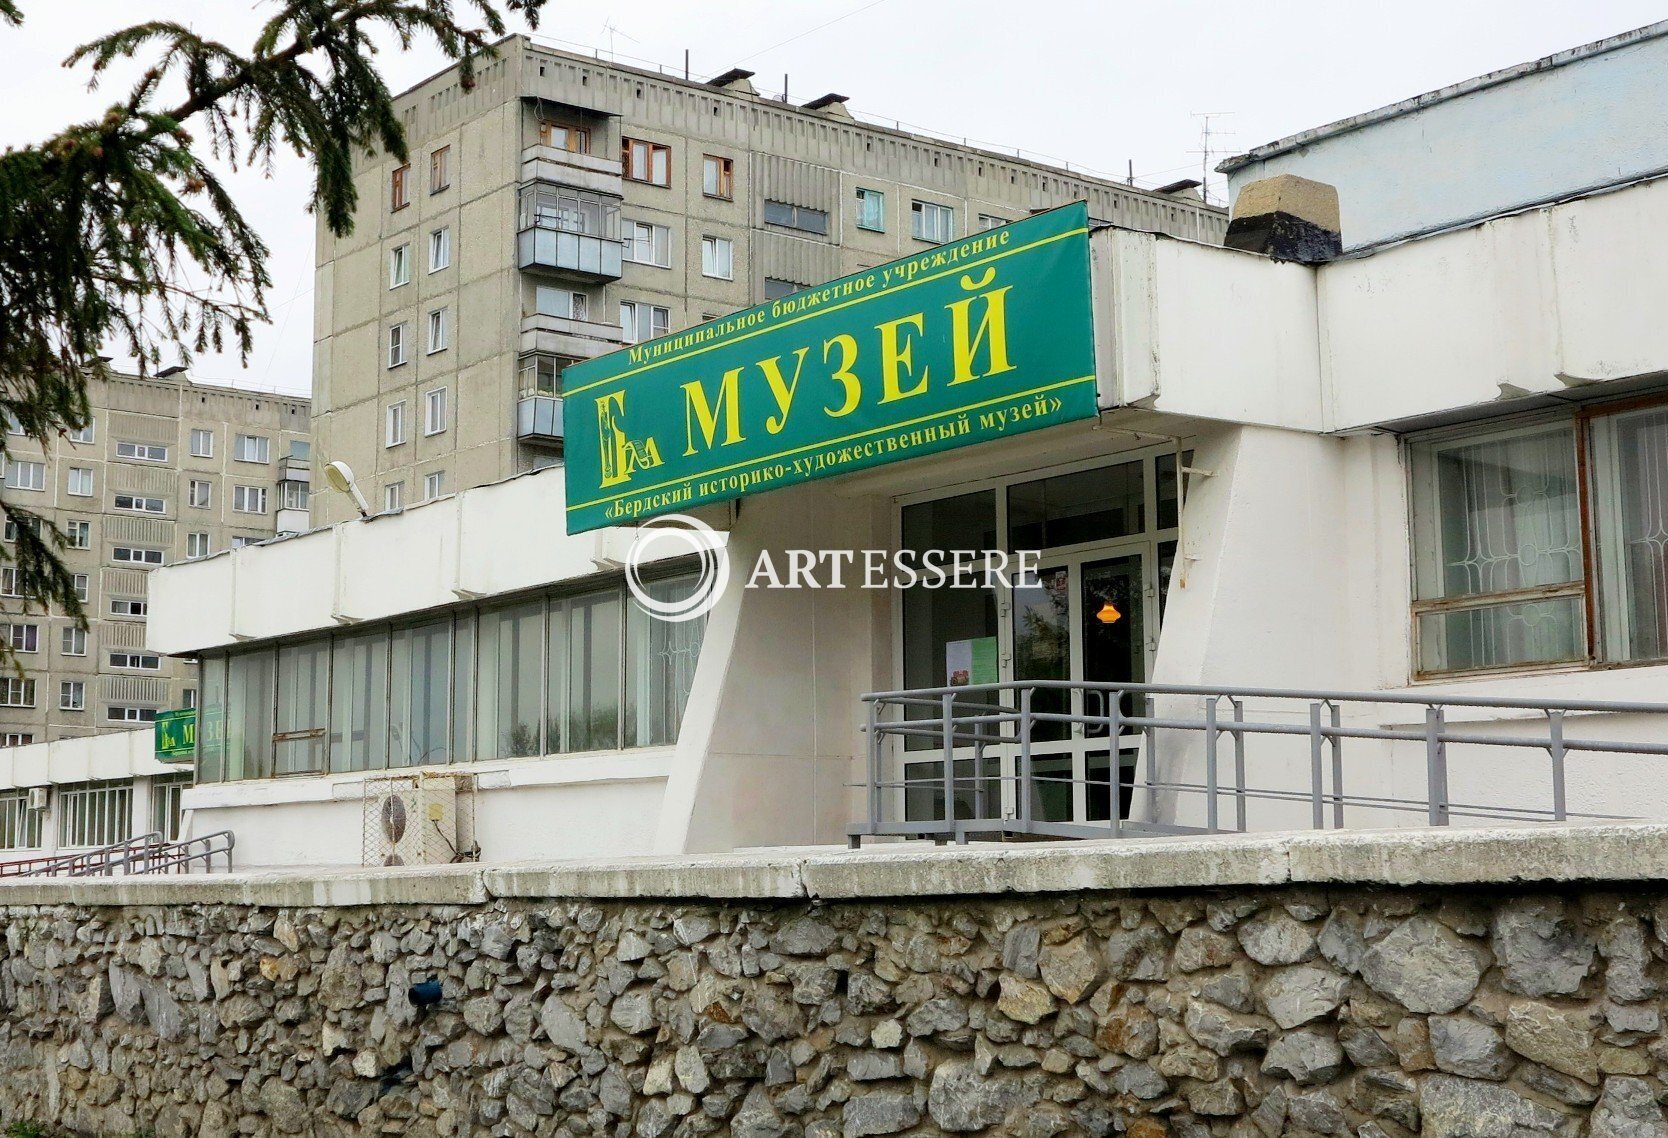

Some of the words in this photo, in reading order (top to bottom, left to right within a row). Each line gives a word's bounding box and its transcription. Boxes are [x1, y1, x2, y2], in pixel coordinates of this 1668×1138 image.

[628, 310, 766, 365] Муниципальное
[772, 274, 875, 319] бюджетное
[882, 230, 1010, 288] учреждение
[680, 266, 1017, 457] МУЗЕЙ
[604, 482, 693, 520] «Бердский
[699, 414, 971, 497] историко-художественный
[979, 394, 1063, 431] музей»
